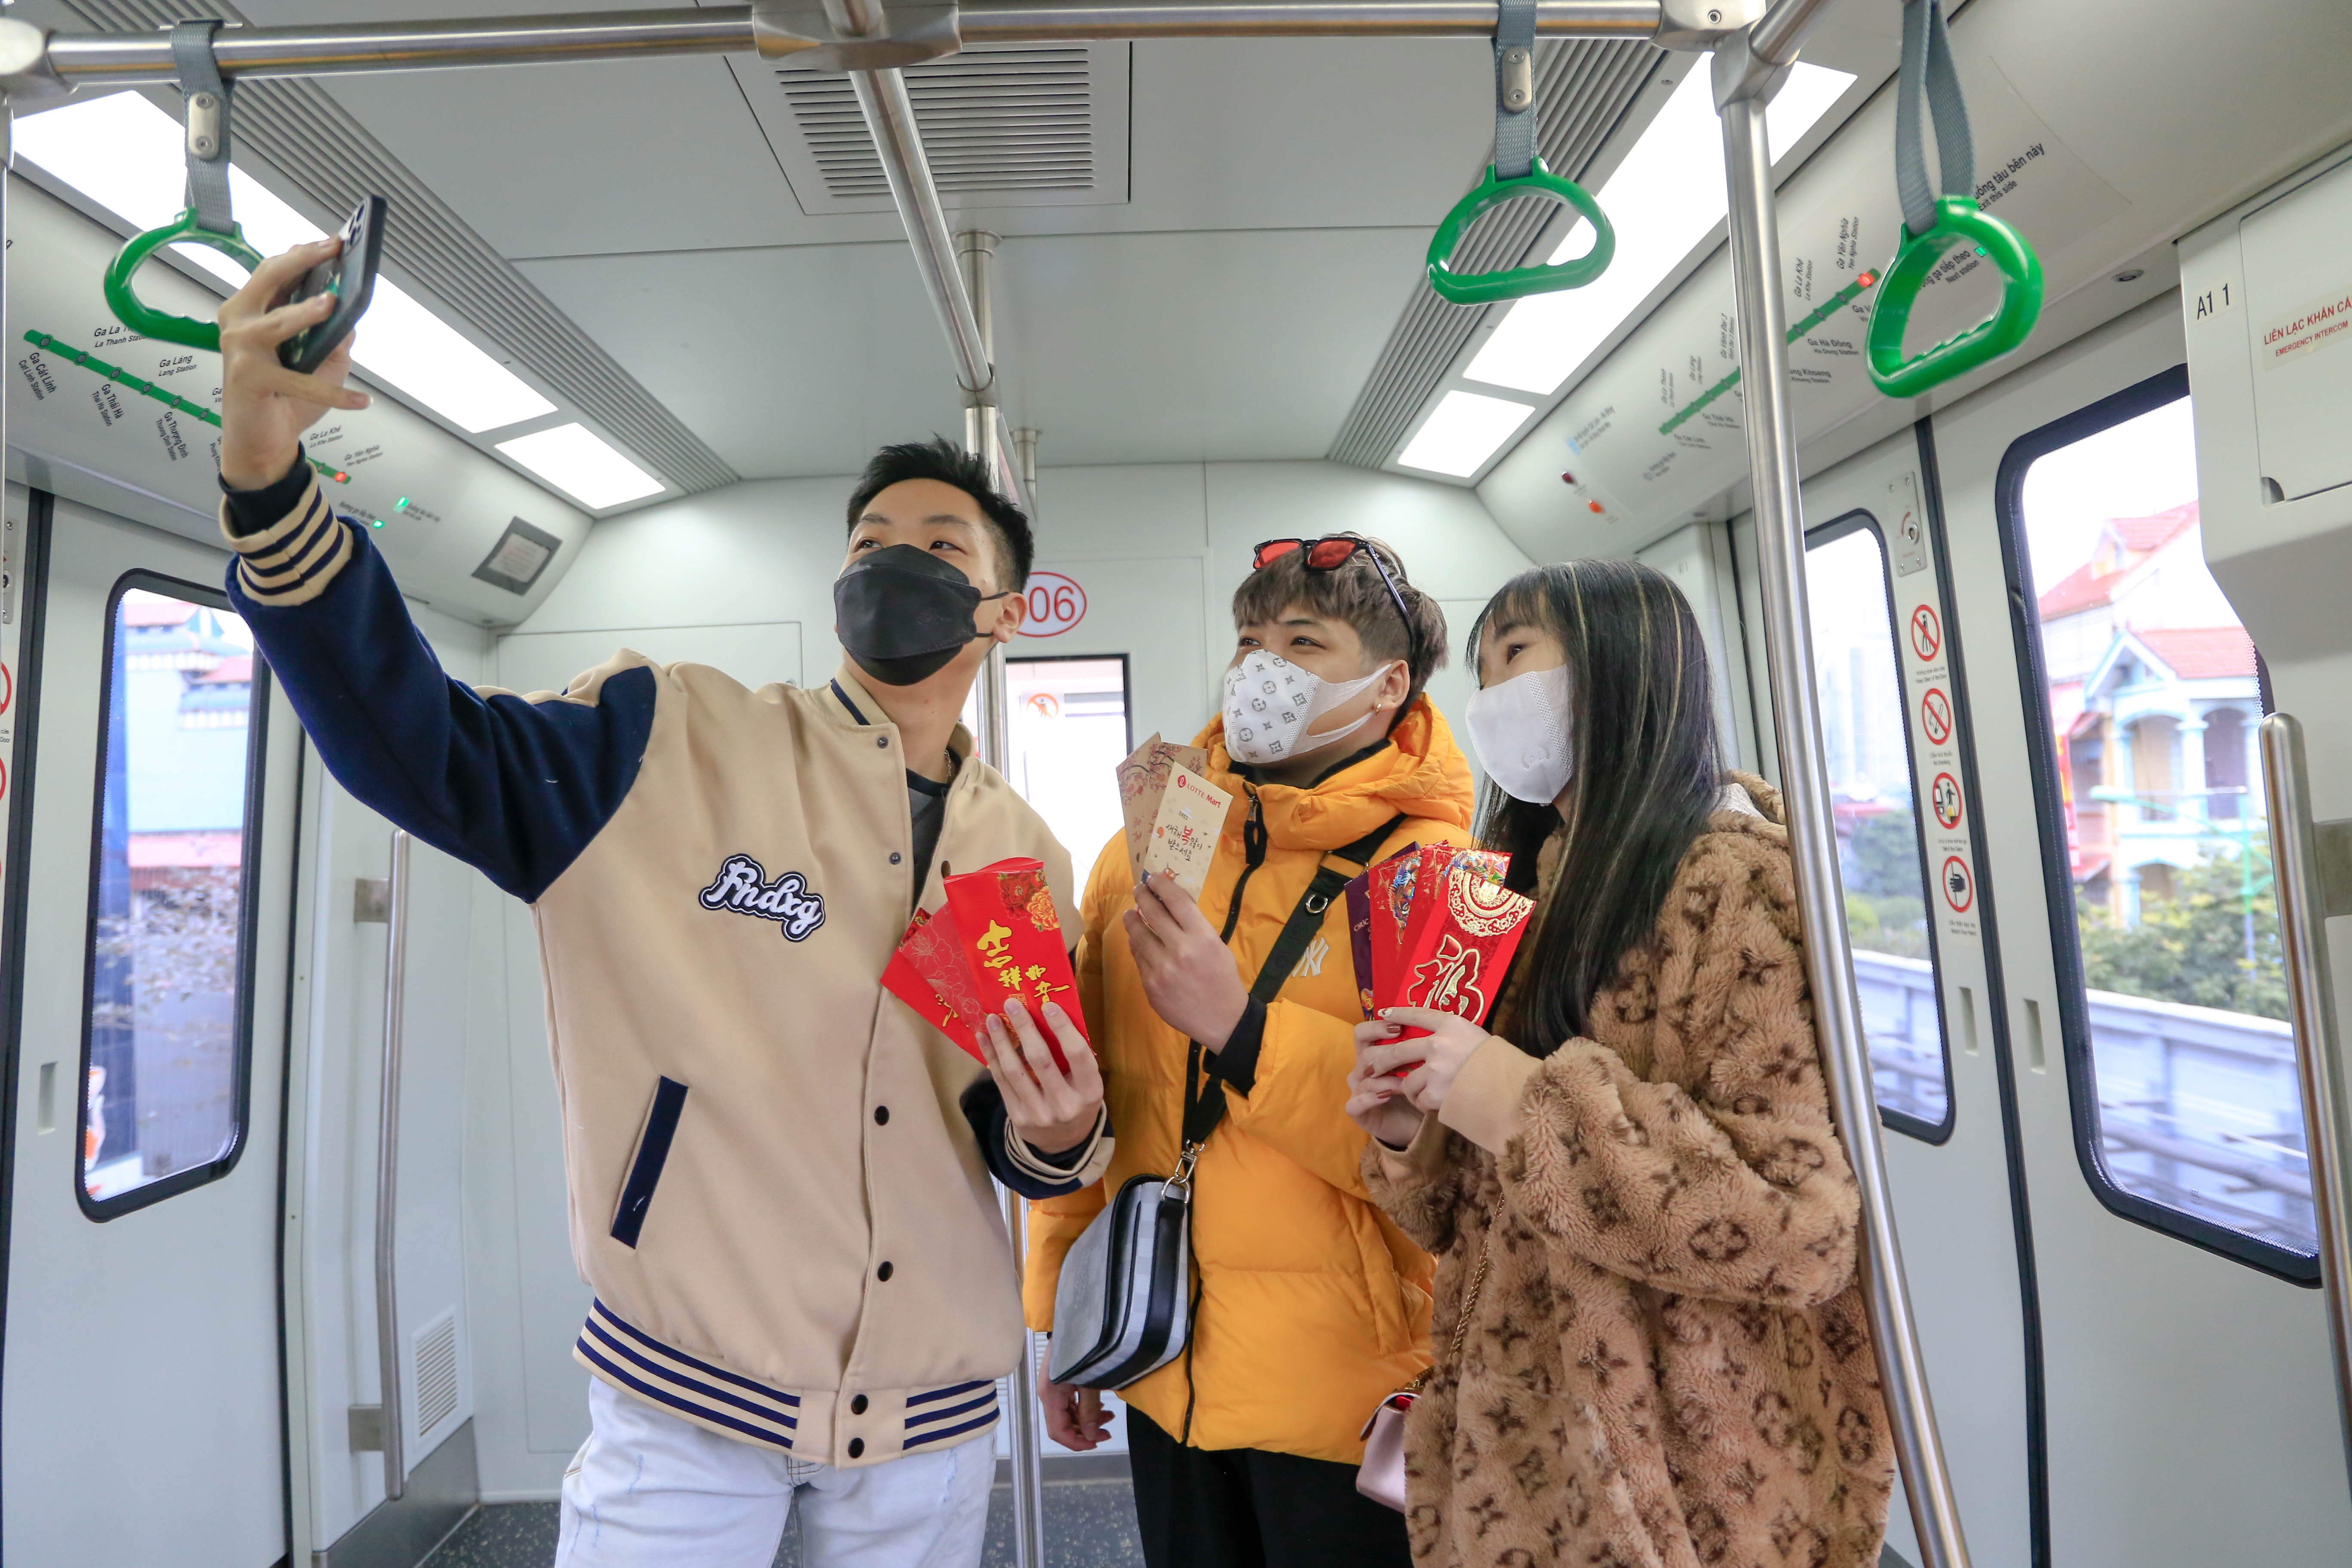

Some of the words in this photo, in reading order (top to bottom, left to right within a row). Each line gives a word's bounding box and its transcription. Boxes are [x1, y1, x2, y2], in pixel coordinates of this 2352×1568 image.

[1993, 169, 2009, 184] tàu
[2006, 157, 2027, 173] bên
[2026, 143, 2045, 160] này
[1978, 199, 1991, 211] Exit
[1989, 191, 2003, 202] this
[2003, 181, 2017, 193] side
[1851, 217, 1859, 239] Station
[1837, 258, 1845, 269] Ga
[1952, 251, 1970, 264] theo
[1960, 260, 1980, 275] station
[1795, 276, 1803, 286] La
[1795, 287, 1802, 297] Ga
[2197, 291, 2213, 320] A1
[2222, 283, 2229, 306] 1
[94, 328, 106, 337] Ga
[109, 326, 120, 334] La
[106, 337, 126, 346] Thanh
[2264, 329, 2284, 345] LIÊN
[2286, 319, 2305, 336] LẠC
[2275, 335, 2313, 357] EMERGENCY
[2314, 321, 2349, 340] INTERCOM
[30, 352, 40, 364] Ga
[36, 364, 46, 377] Cát
[42, 376, 57, 393] Linh
[159, 359, 170, 368] Ga
[173, 355, 193, 365] Láng
[159, 368, 174, 377] Lang
[176, 364, 197, 373] Station
[24, 369, 34, 383] Linh
[31, 381, 44, 401] Station
[101, 384, 110, 395] Ga
[106, 394, 120, 410] Thái
[101, 409, 112, 426] Station
[164, 412, 172, 422] Ga
[1187, 783, 1205, 798] LOTTE
[1206, 794, 1221, 808] Mart
[1166, 824, 1182, 839] 새해
[1182, 825, 1194, 845] 복
[1190, 837, 1203, 850] 많이
[1168, 838, 1192, 861] 받으세요
